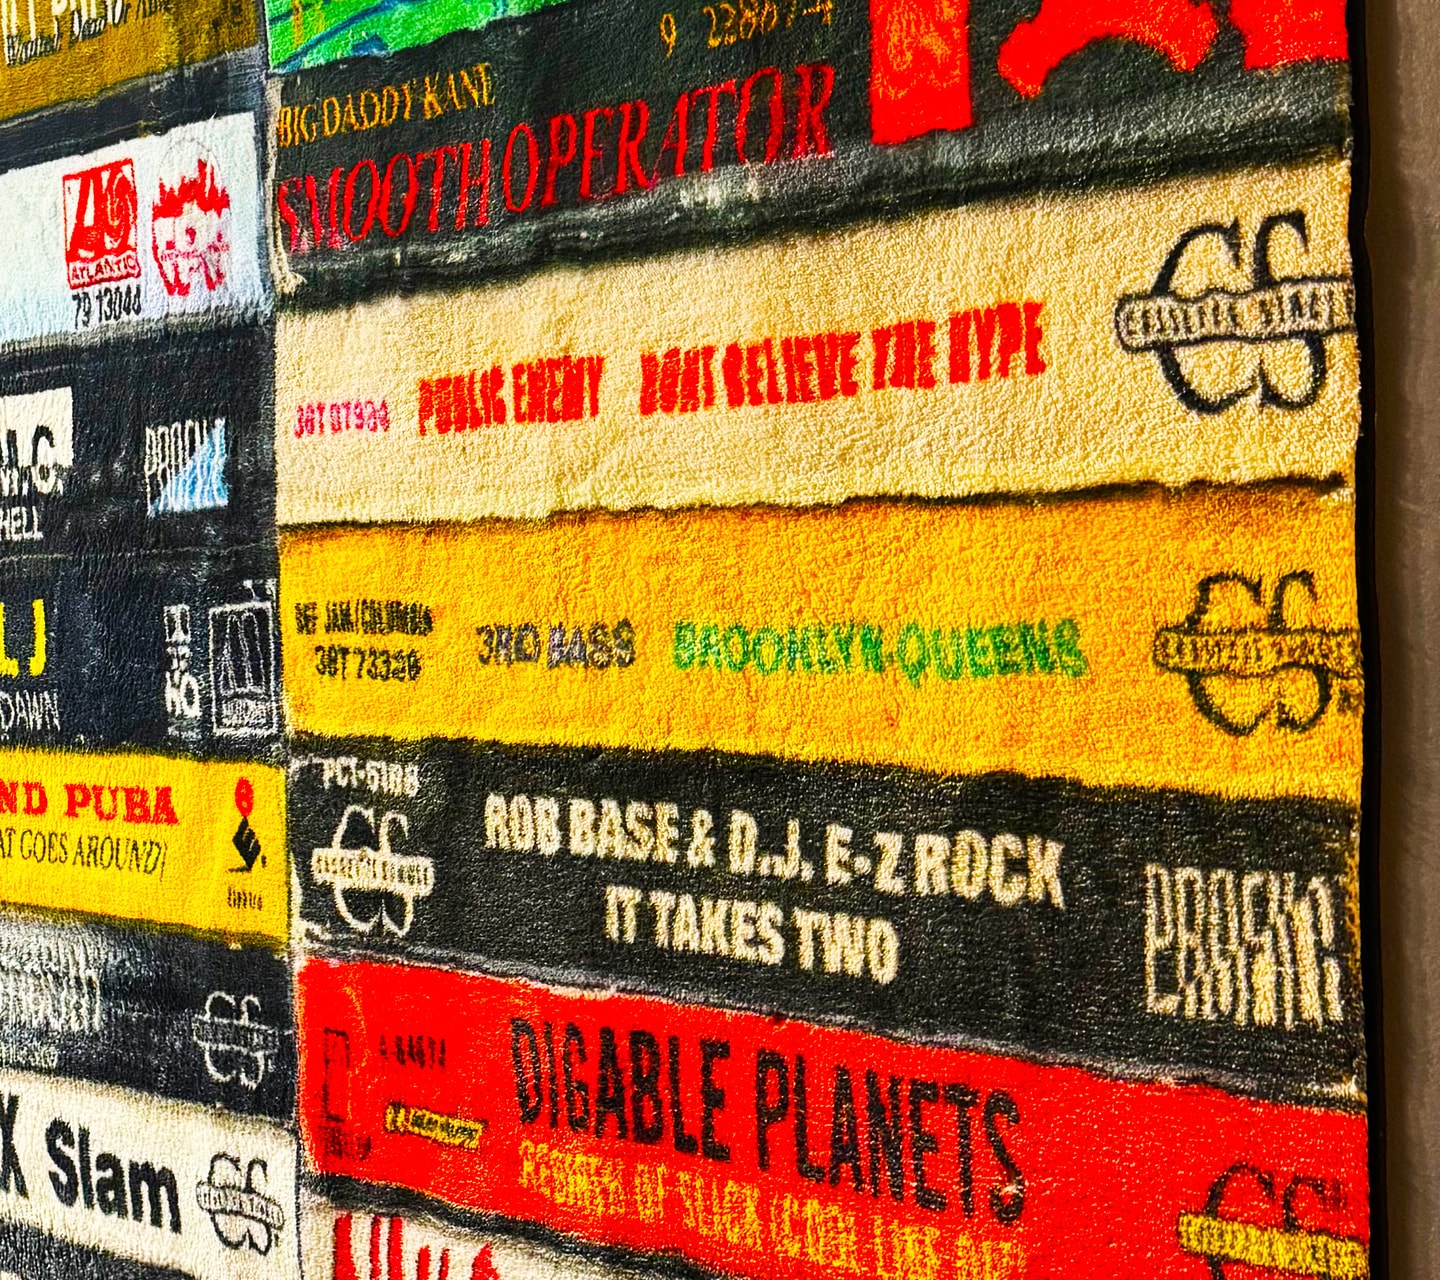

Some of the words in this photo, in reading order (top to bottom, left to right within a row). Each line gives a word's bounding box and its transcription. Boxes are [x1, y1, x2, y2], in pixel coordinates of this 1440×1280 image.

[278, 104, 317, 149] BIG
[423, 62, 496, 120] KANE
[278, 138, 492, 255] SMOOTH
[502, 64, 837, 215] OPERATOR
[721, 331, 860, 408] BELIEVE
[871, 320, 937, 390] THE
[949, 301, 1047, 386] HYPE
[29, 598, 47, 678] J
[20, 831, 68, 865] GOES
[65, 785, 179, 825] PUBA
[484, 792, 562, 856] ROB
[568, 798, 680, 864] BASE
[687, 810, 717, 868] &
[914, 830, 1065, 909] ROCK
[604, 885, 642, 944] IT
[649, 887, 785, 966] TAKES
[792, 906, 899, 985] TWO
[510, 1018, 731, 1164] DIGABLE
[755, 1049, 1026, 1226] PLANETS
[44, 1116, 182, 1235] Slam
